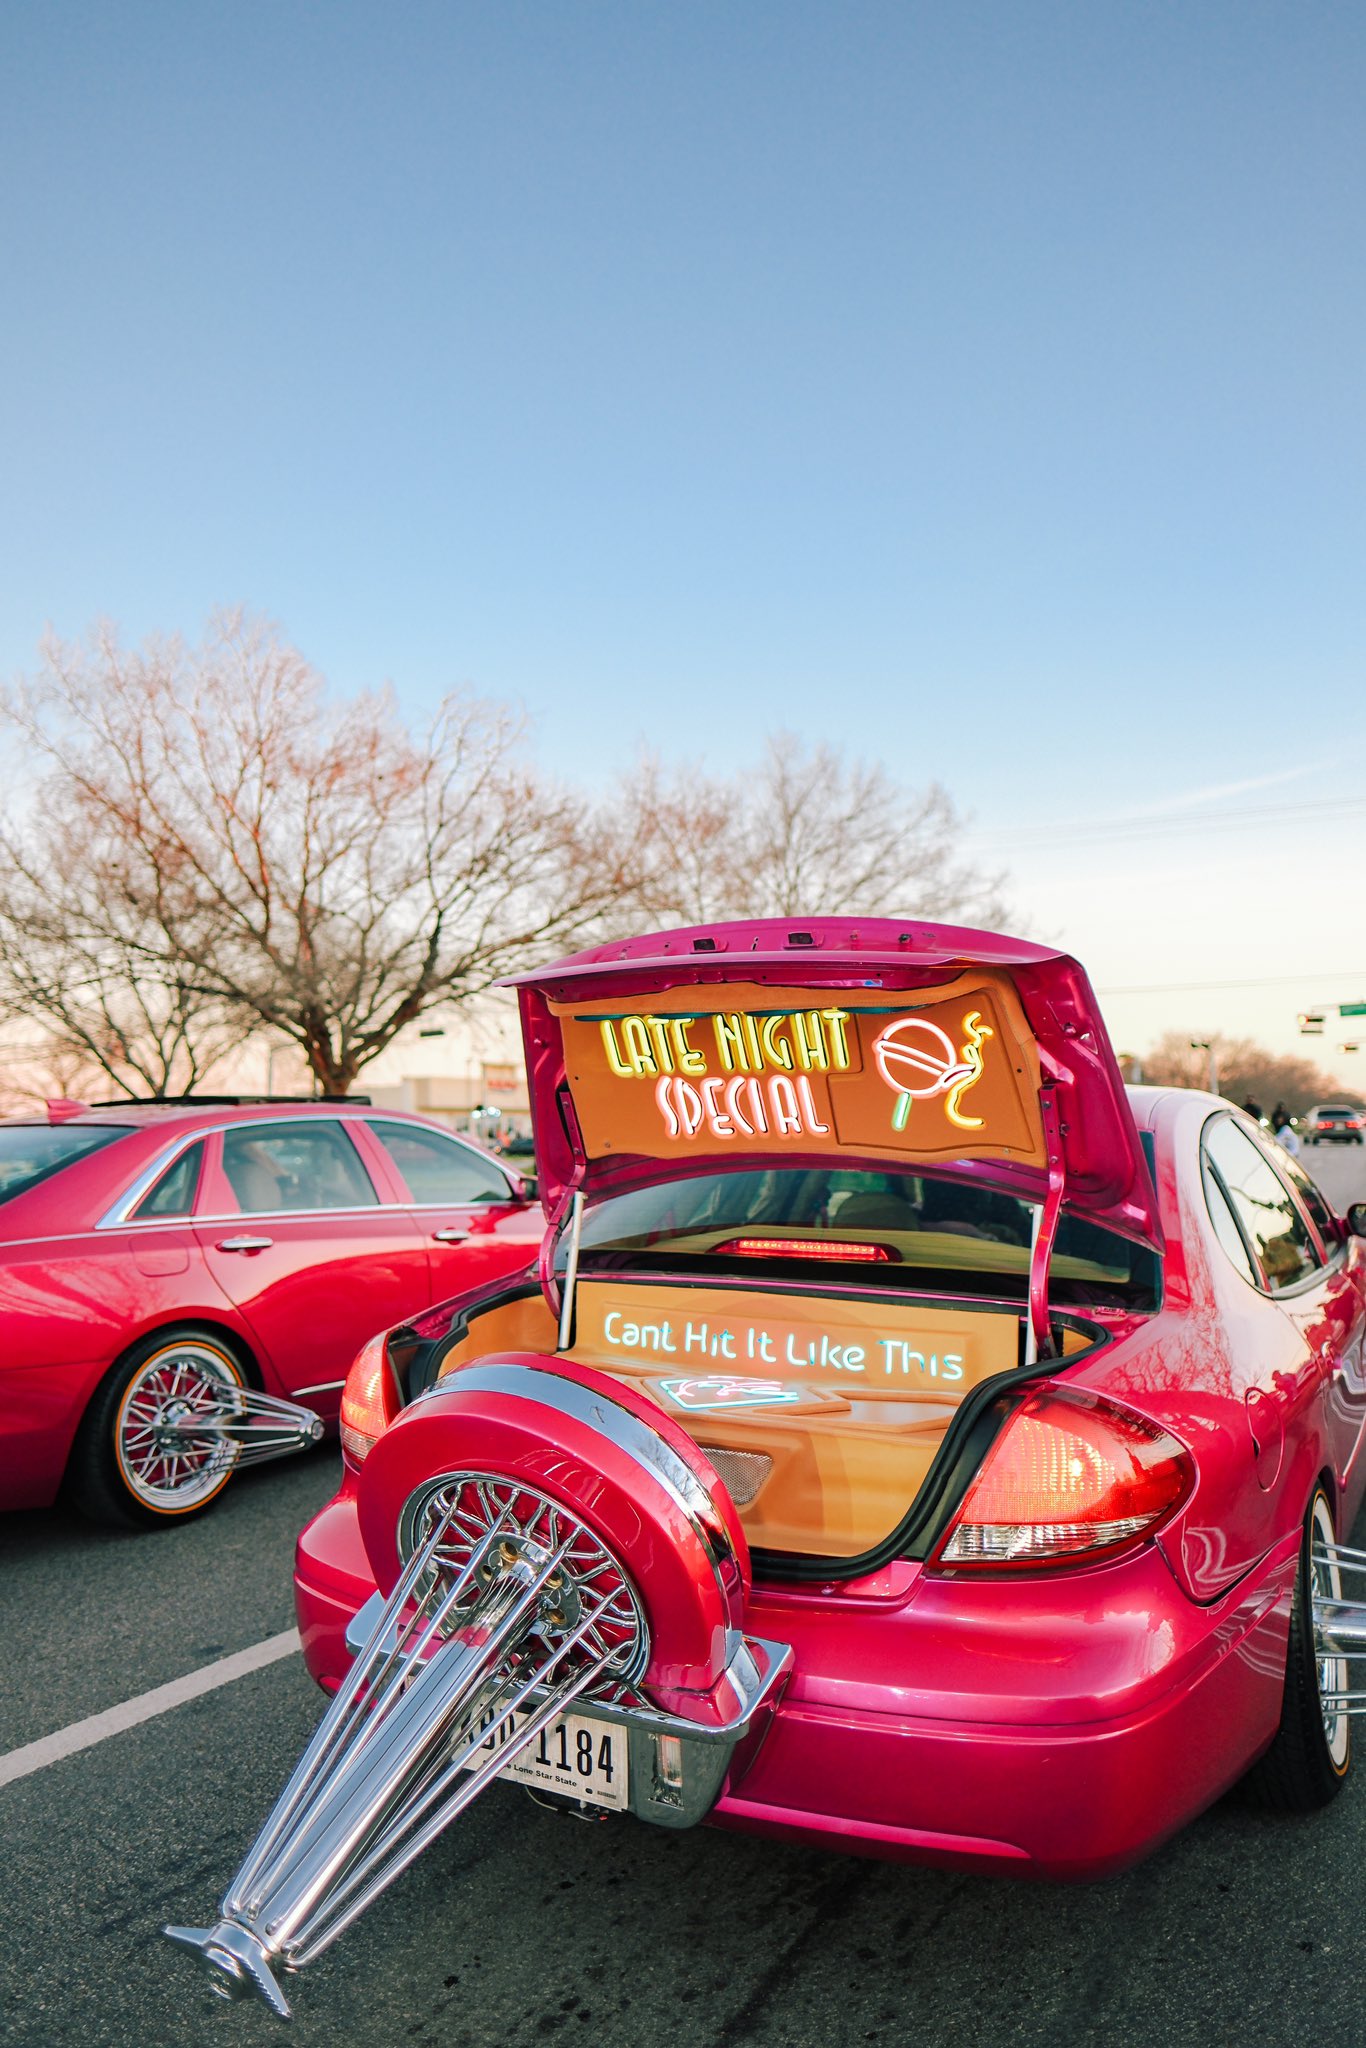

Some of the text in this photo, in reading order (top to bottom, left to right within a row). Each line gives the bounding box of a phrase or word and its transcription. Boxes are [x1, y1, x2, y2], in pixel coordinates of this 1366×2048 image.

[603, 1011, 849, 1074] LATE NIGHT
[656, 1076, 830, 1136] SPECIAL
[604, 1312, 964, 1381] Cant Hit It Like This
[514, 1764, 533, 1775] Lone
[536, 1770, 553, 1780] Star
[555, 1775, 577, 1787] State
[535, 1724, 614, 1783] 1184
